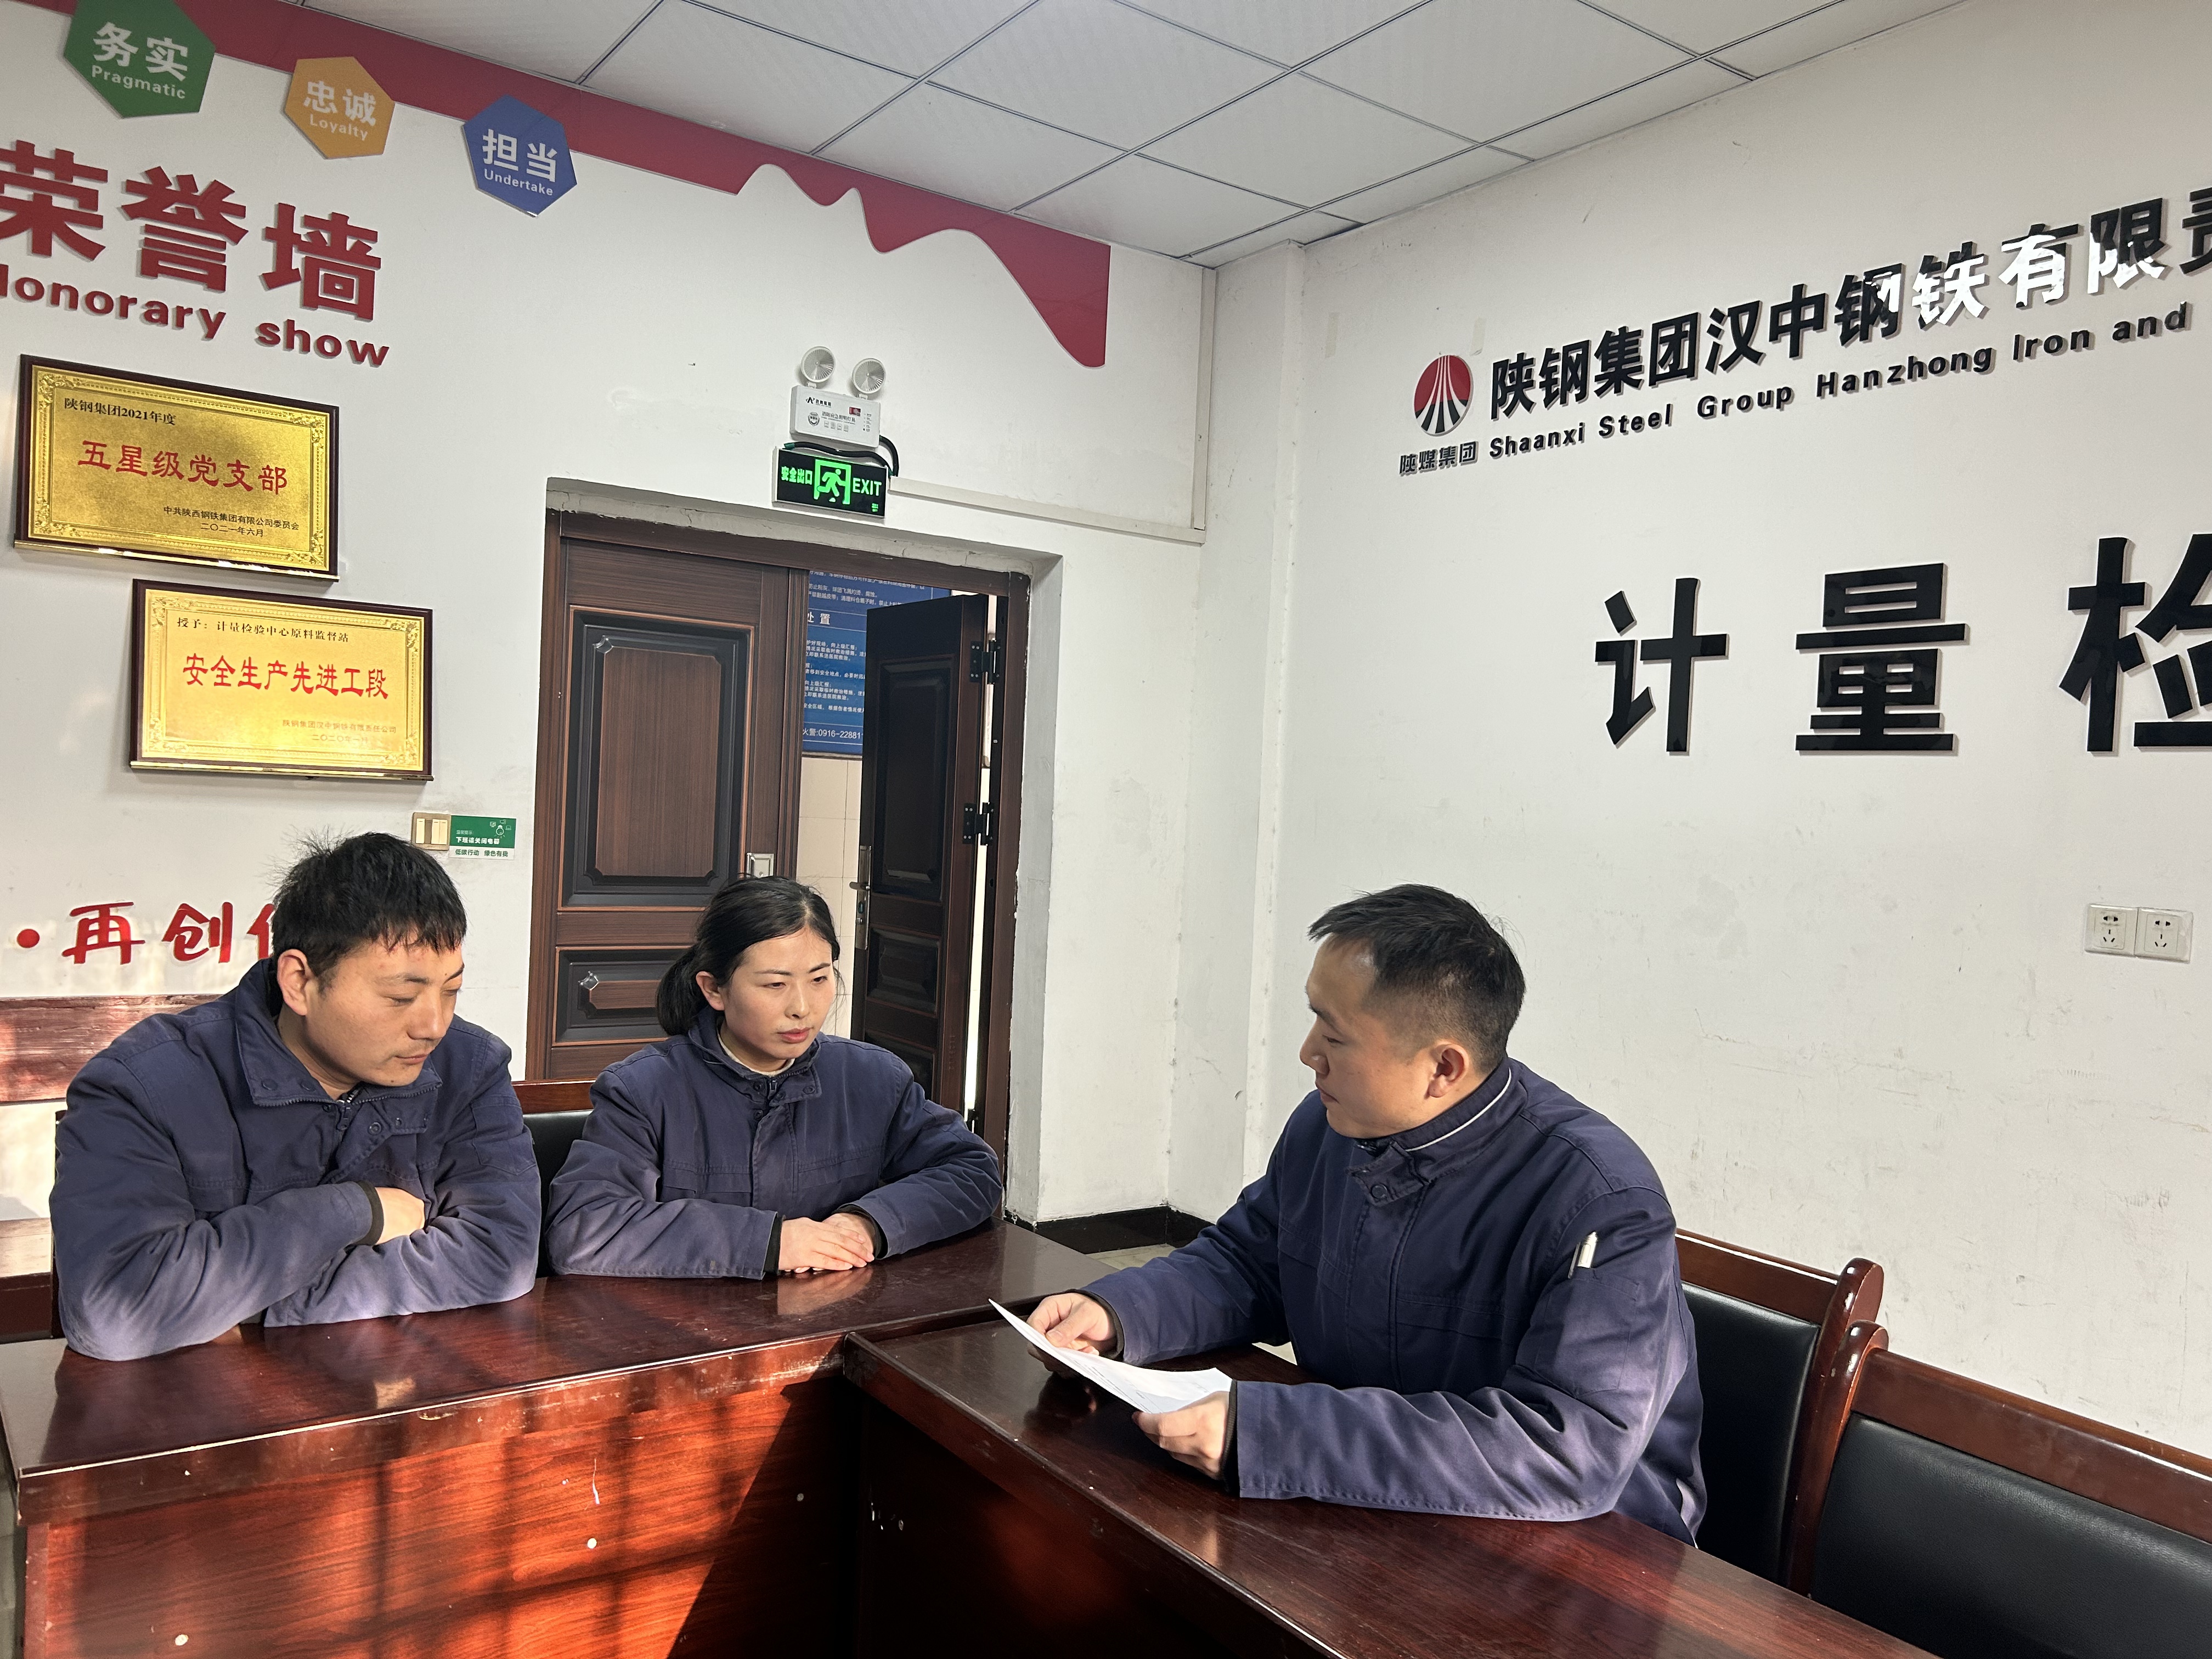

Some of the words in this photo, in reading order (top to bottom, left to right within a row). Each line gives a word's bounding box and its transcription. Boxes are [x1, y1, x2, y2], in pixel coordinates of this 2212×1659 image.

[93, 22, 189, 81] 务实
[91, 65, 186, 100] Pragmatic
[303, 79, 377, 126] 忠诚
[309, 114, 368, 142] Loyalty
[482, 128, 558, 183] 担当
[483, 169, 554, 196] Undertake
[0, 139, 382, 323] 荣誉墙
[255, 319, 390, 366] show
[1489, 422, 1585, 458] Shaanxi
[1599, 404, 1672, 437] Steel
[1697, 383, 1793, 419] Group
[1816, 347, 1993, 398] Hanzhong
[2013, 328, 2091, 361] Iron
[2112, 301, 2187, 342] and
[64, 397, 177, 426] 陕钢集团2021年度
[77, 440, 288, 495] 五星级党支部
[781, 466, 812, 485] 安全出口
[1400, 441, 1477, 475] 陕煤集团
[853, 477, 882, 496] EXIT
[163, 506, 300, 531] 中共陕西钢铁集团有限公司委员会
[183, 653, 389, 699] 安全生产先进工段
